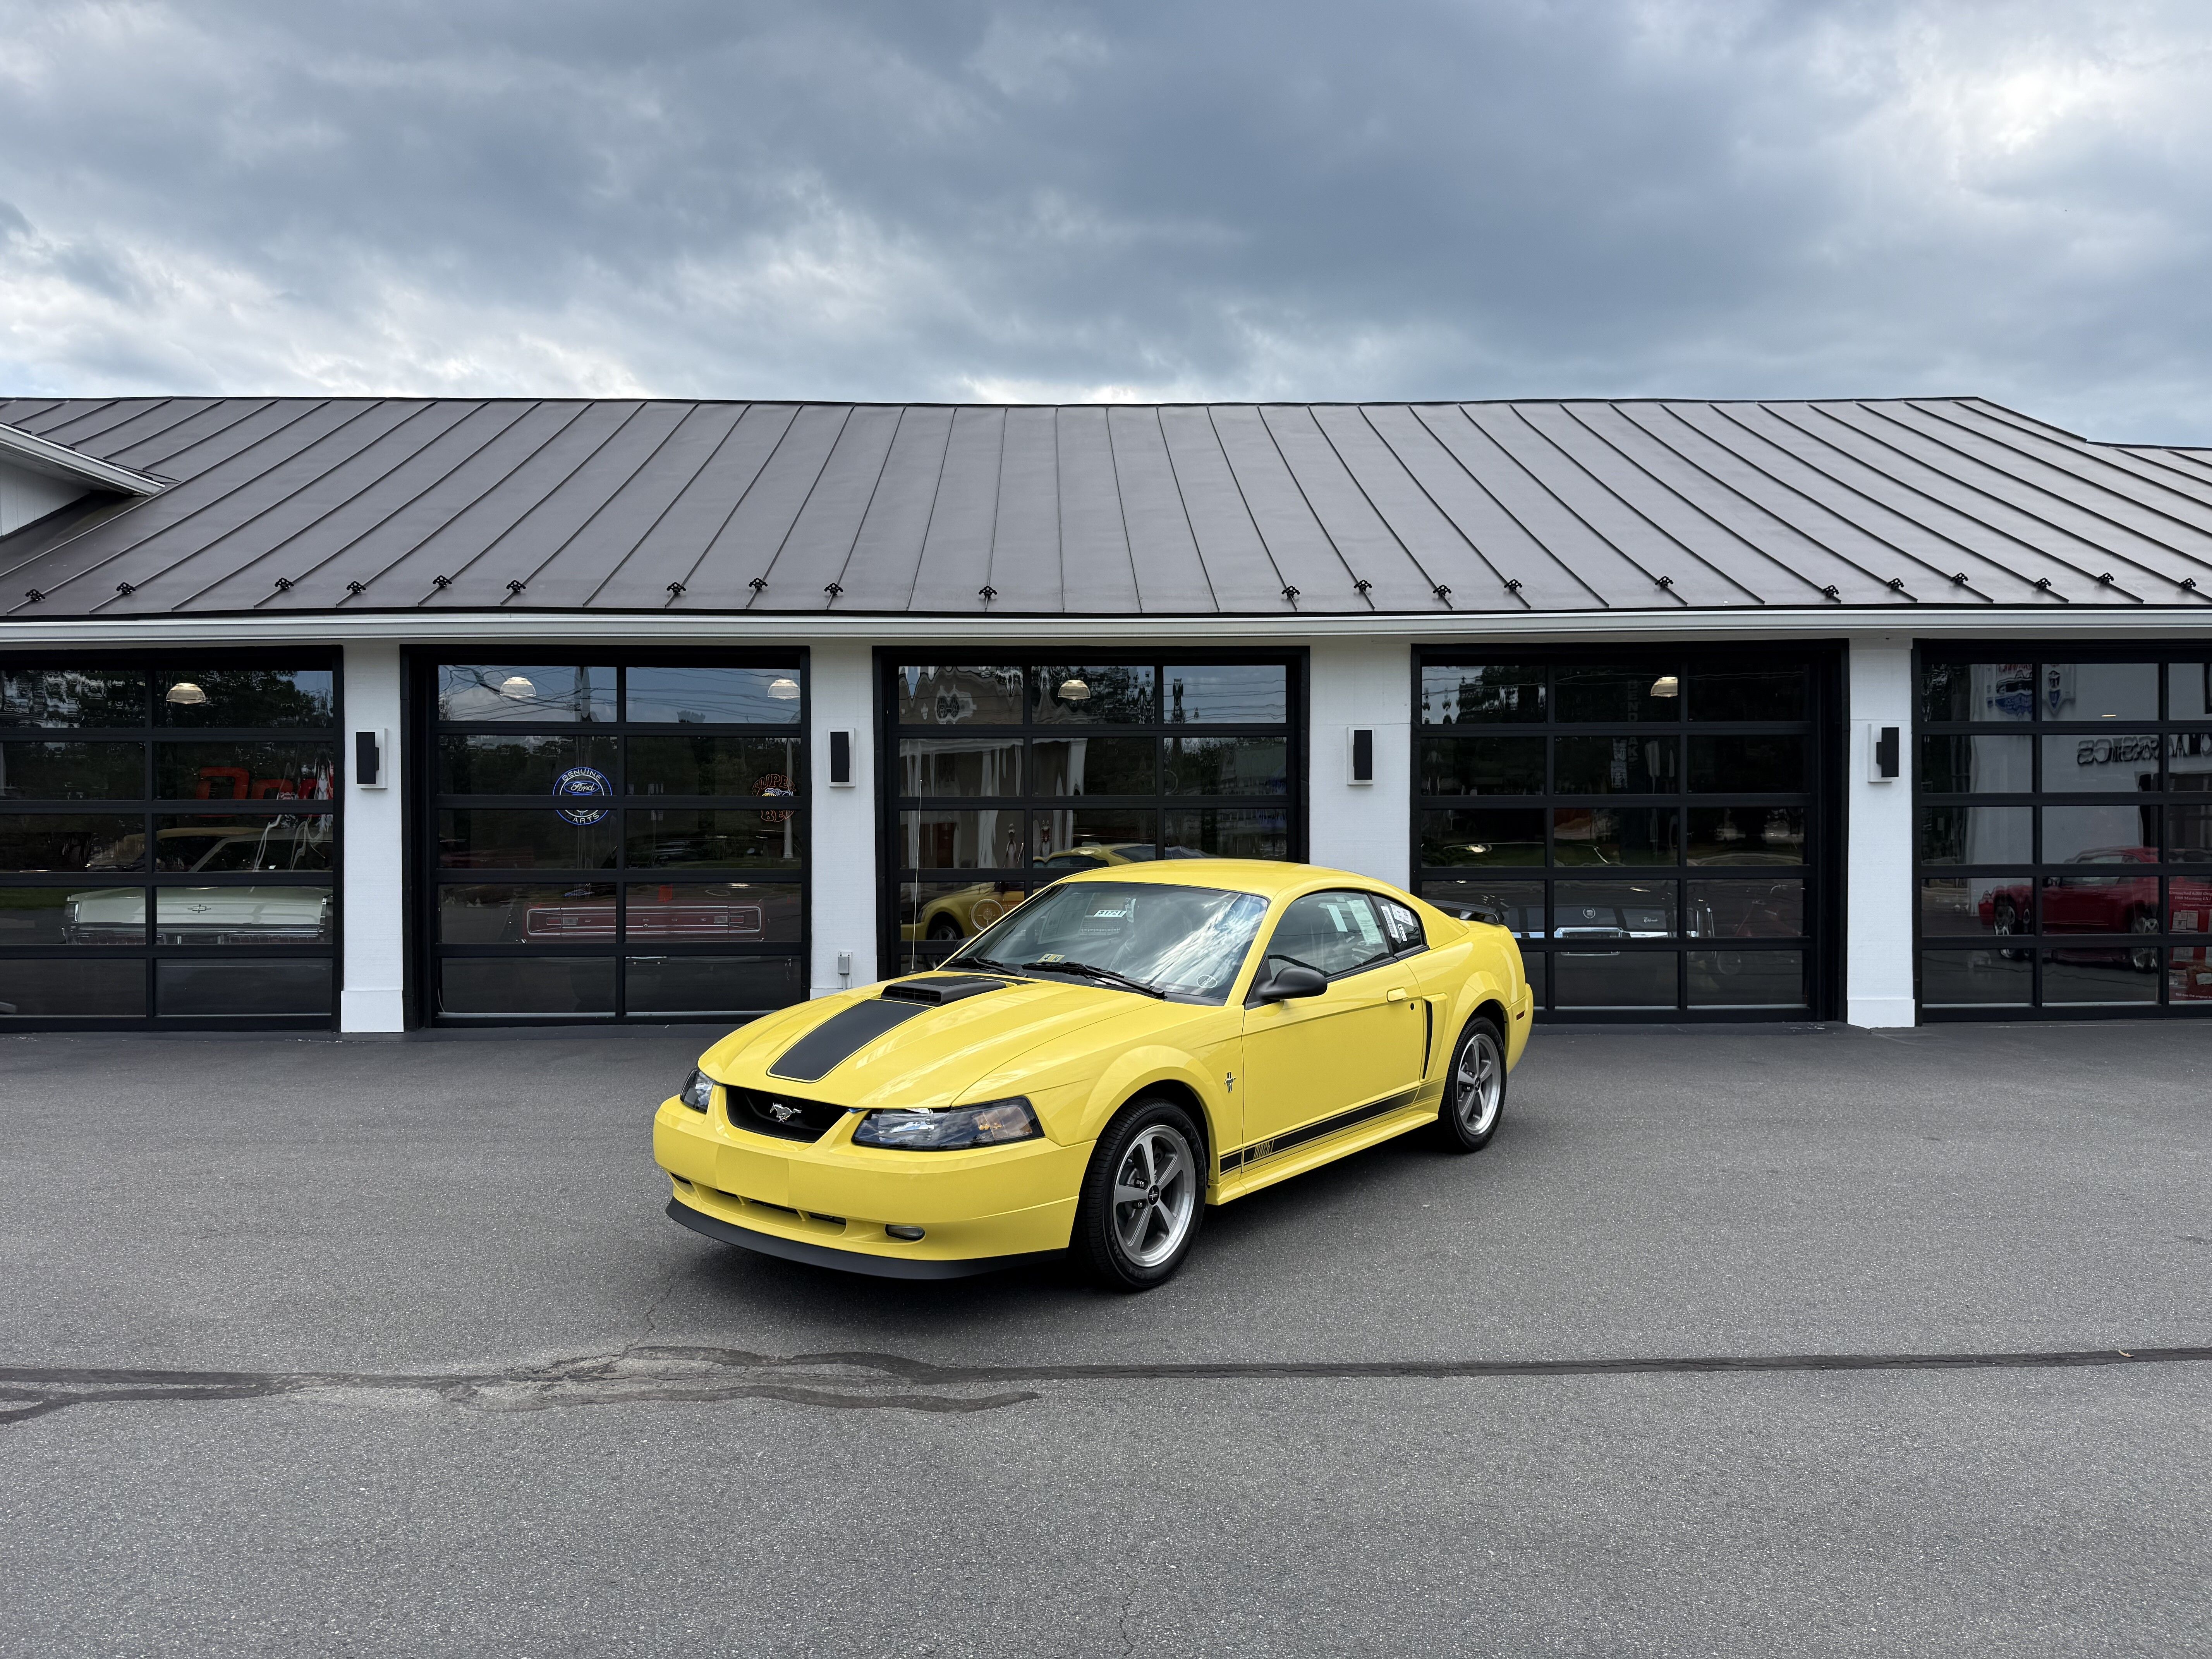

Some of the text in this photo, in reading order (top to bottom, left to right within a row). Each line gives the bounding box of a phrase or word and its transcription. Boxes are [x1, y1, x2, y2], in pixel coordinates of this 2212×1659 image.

[562, 768, 602, 781] GENUINE
[570, 782, 595, 792] Ford
[752, 774, 797, 796] SUPER
